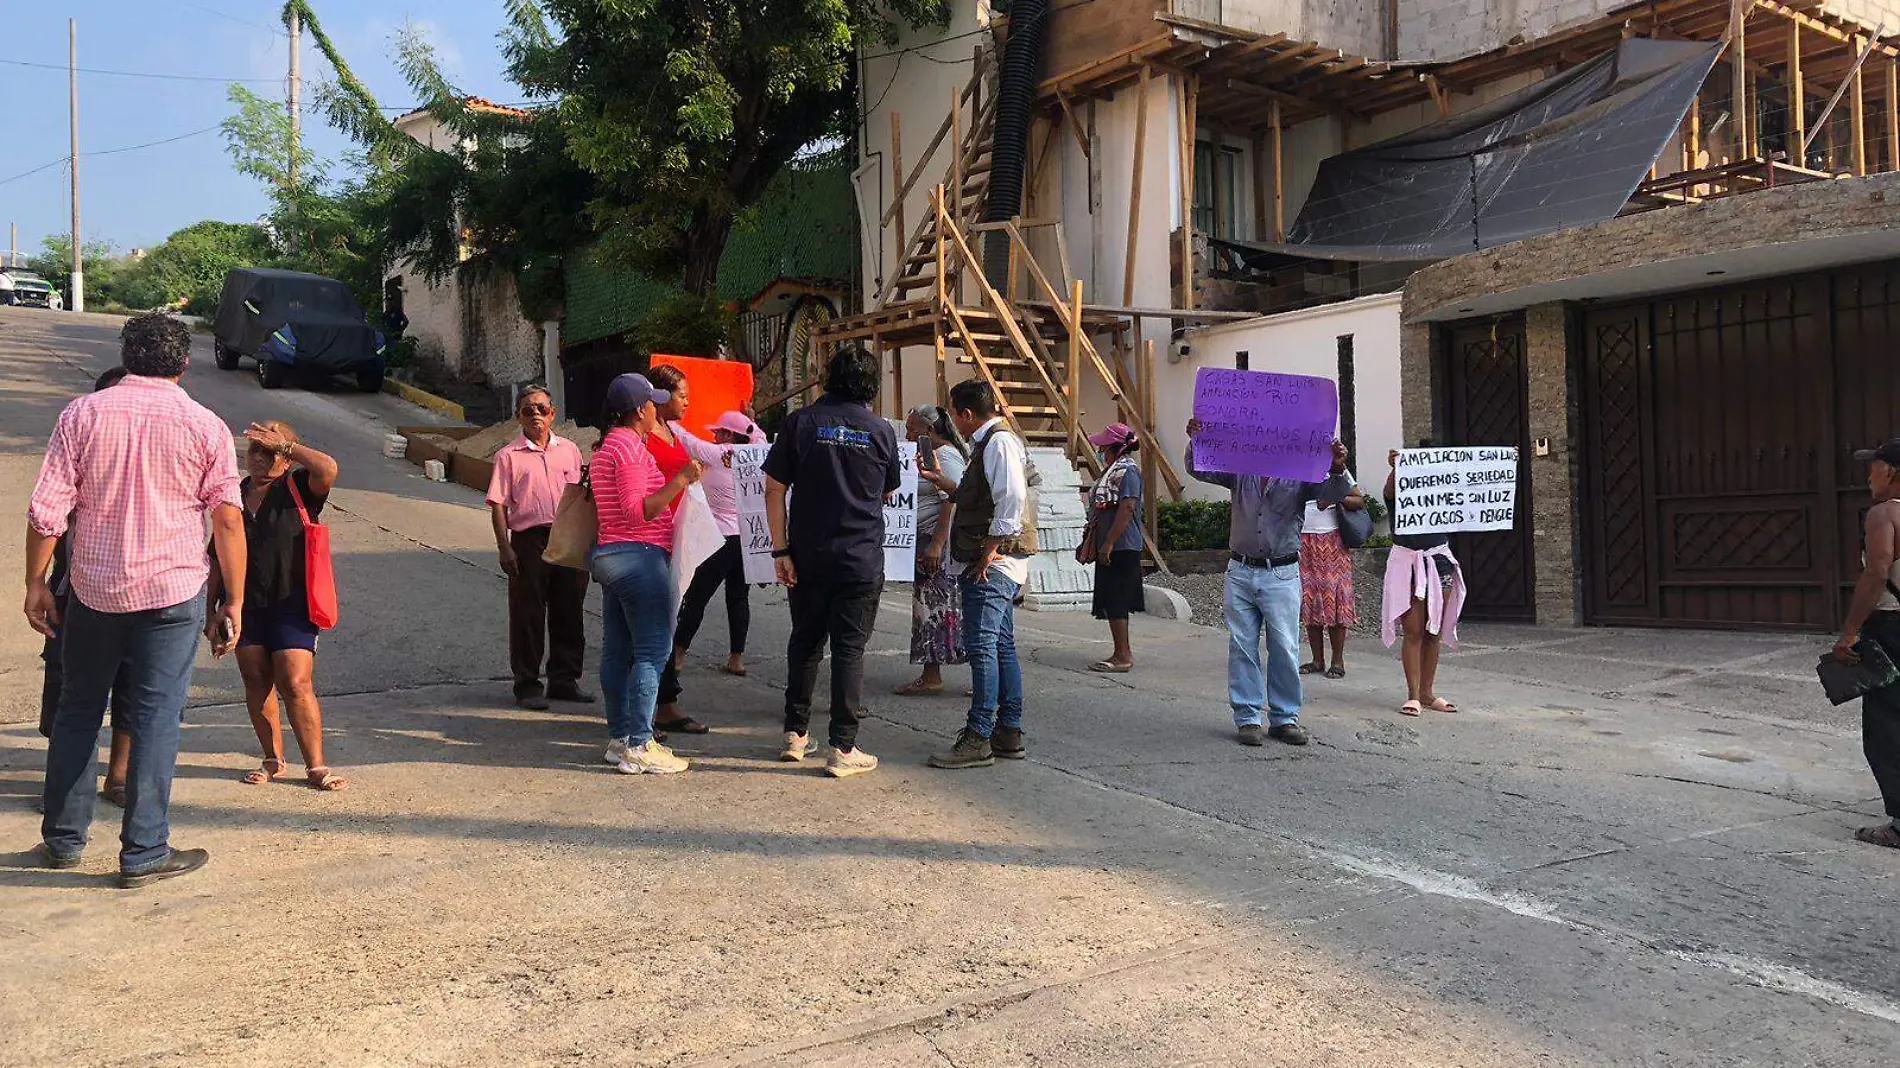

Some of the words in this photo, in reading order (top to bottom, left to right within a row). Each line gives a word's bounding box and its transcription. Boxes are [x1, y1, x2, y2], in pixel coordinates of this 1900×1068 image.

[1255, 374, 1282, 388] SAN
[1399, 450, 1473, 467] AMPLIACION
[1479, 450, 1498, 461] SAN
[741, 482, 748, 496] Y
[1398, 472, 1460, 493] QUEREMOS
[1466, 470, 1515, 484] SERIEDAD
[1398, 496, 1415, 509] YA
[1417, 493, 1434, 508] UN
[1437, 492, 1465, 506] MES
[1468, 492, 1486, 504] SIN
[1488, 489, 1511, 503] LUZ
[746, 515, 765, 535] YA
[898, 514, 913, 529] DE
[1397, 512, 1427, 529] HAY
[1429, 509, 1465, 527] CASOS
[1480, 508, 1513, 523] DENGUE
